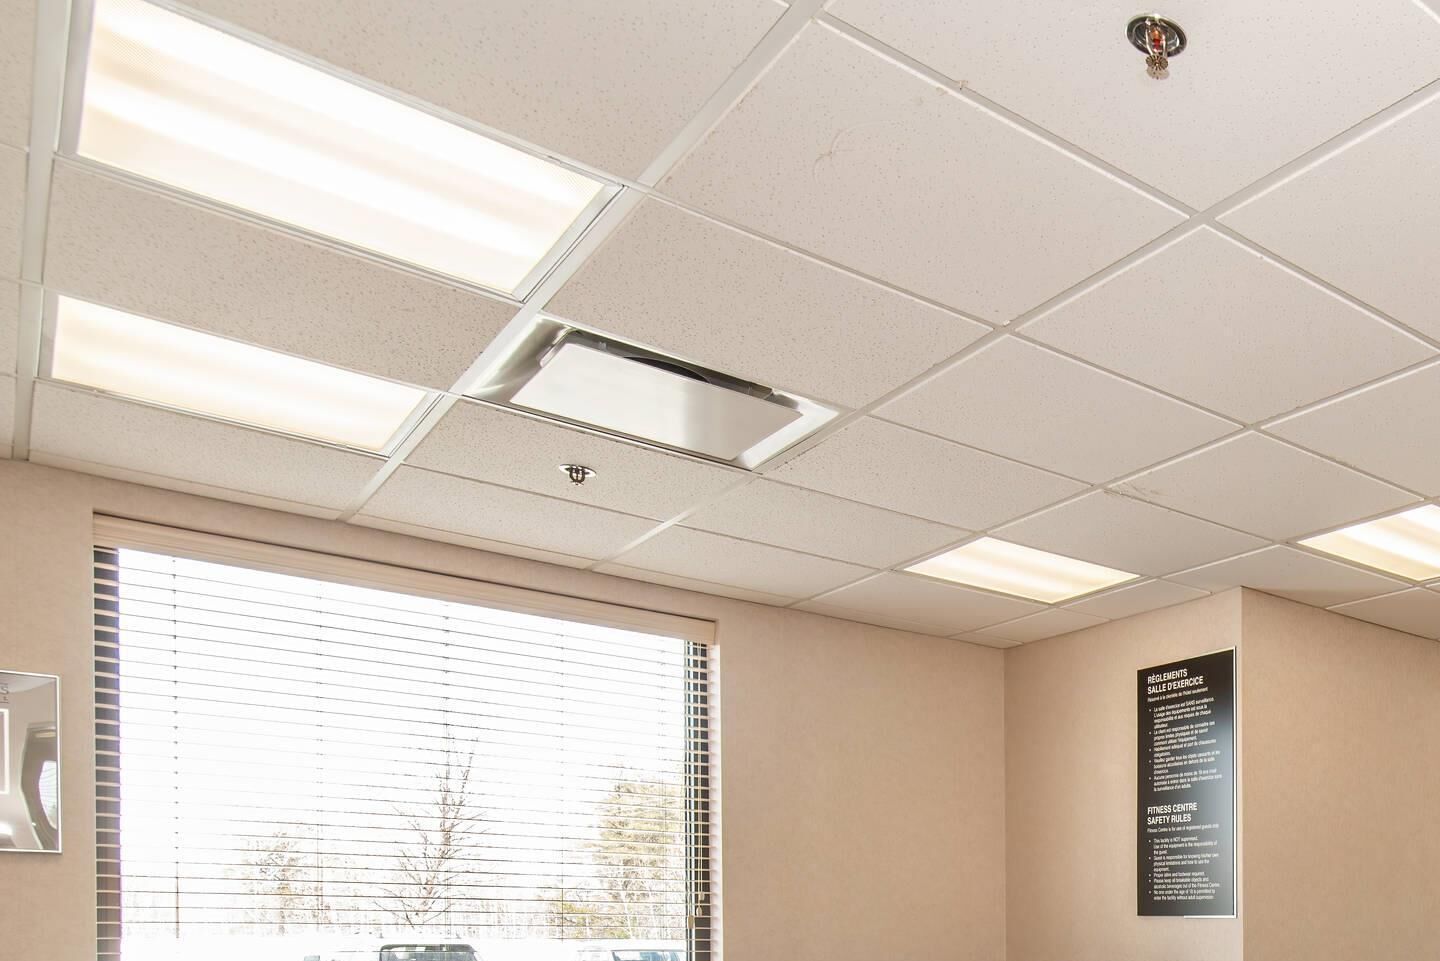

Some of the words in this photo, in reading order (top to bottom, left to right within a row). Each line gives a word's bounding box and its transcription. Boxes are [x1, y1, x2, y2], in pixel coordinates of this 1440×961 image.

[1147, 668, 1187, 684] RÈGLEMENTS
[1148, 684, 1166, 694] SALLE
[1168, 675, 1203, 690] D'EXERCICE
[1148, 805, 1171, 814] FITNESS
[1173, 803, 1197, 812] CENTRE
[1147, 816, 1170, 825] SAFETY
[1171, 814, 1191, 822] RULES
